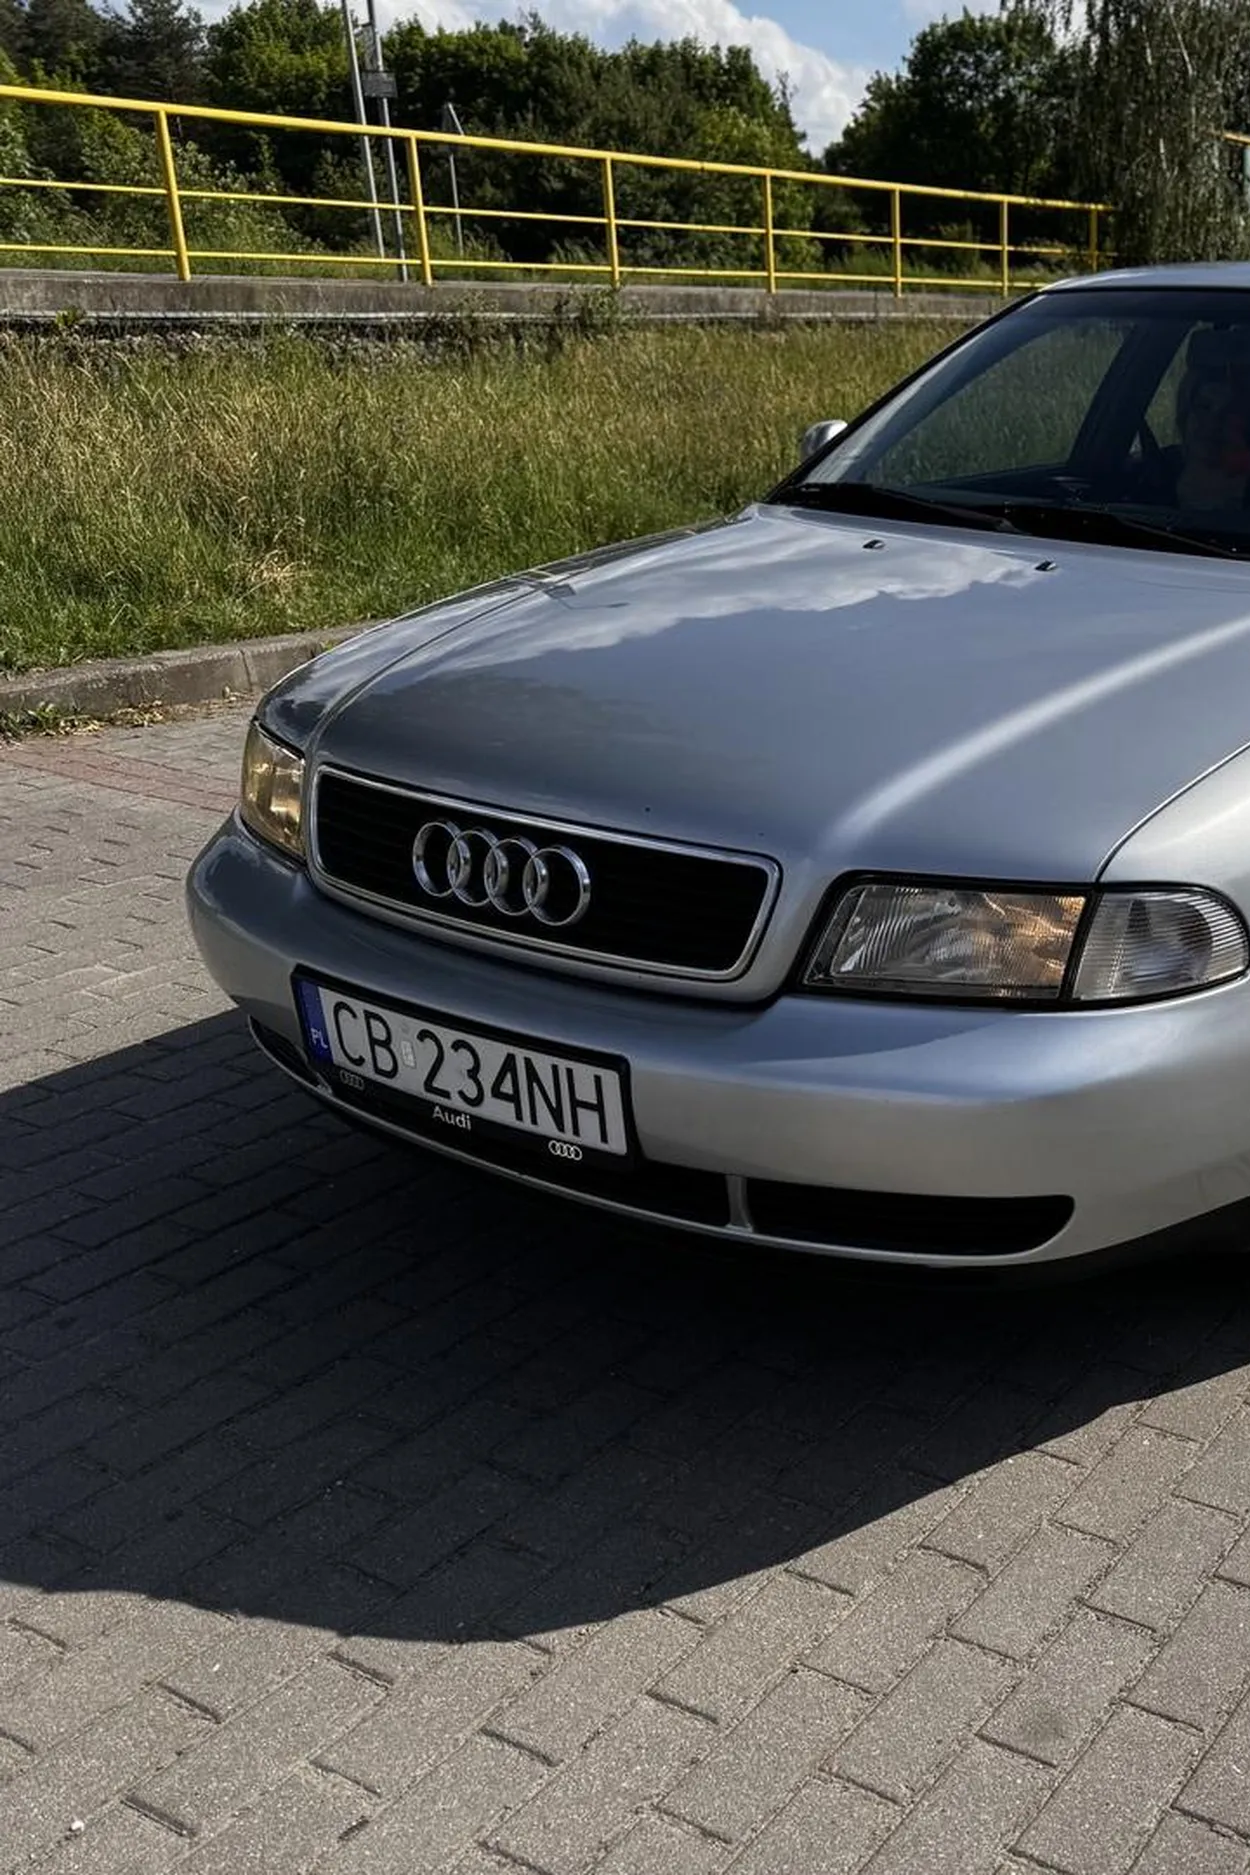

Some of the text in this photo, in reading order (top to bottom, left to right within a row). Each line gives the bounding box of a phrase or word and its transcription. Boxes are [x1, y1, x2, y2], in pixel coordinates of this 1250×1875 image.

[311, 1028, 329, 1049] PL
[333, 1001, 609, 1144] CB 234NH
[432, 1105, 471, 1131] Audi
